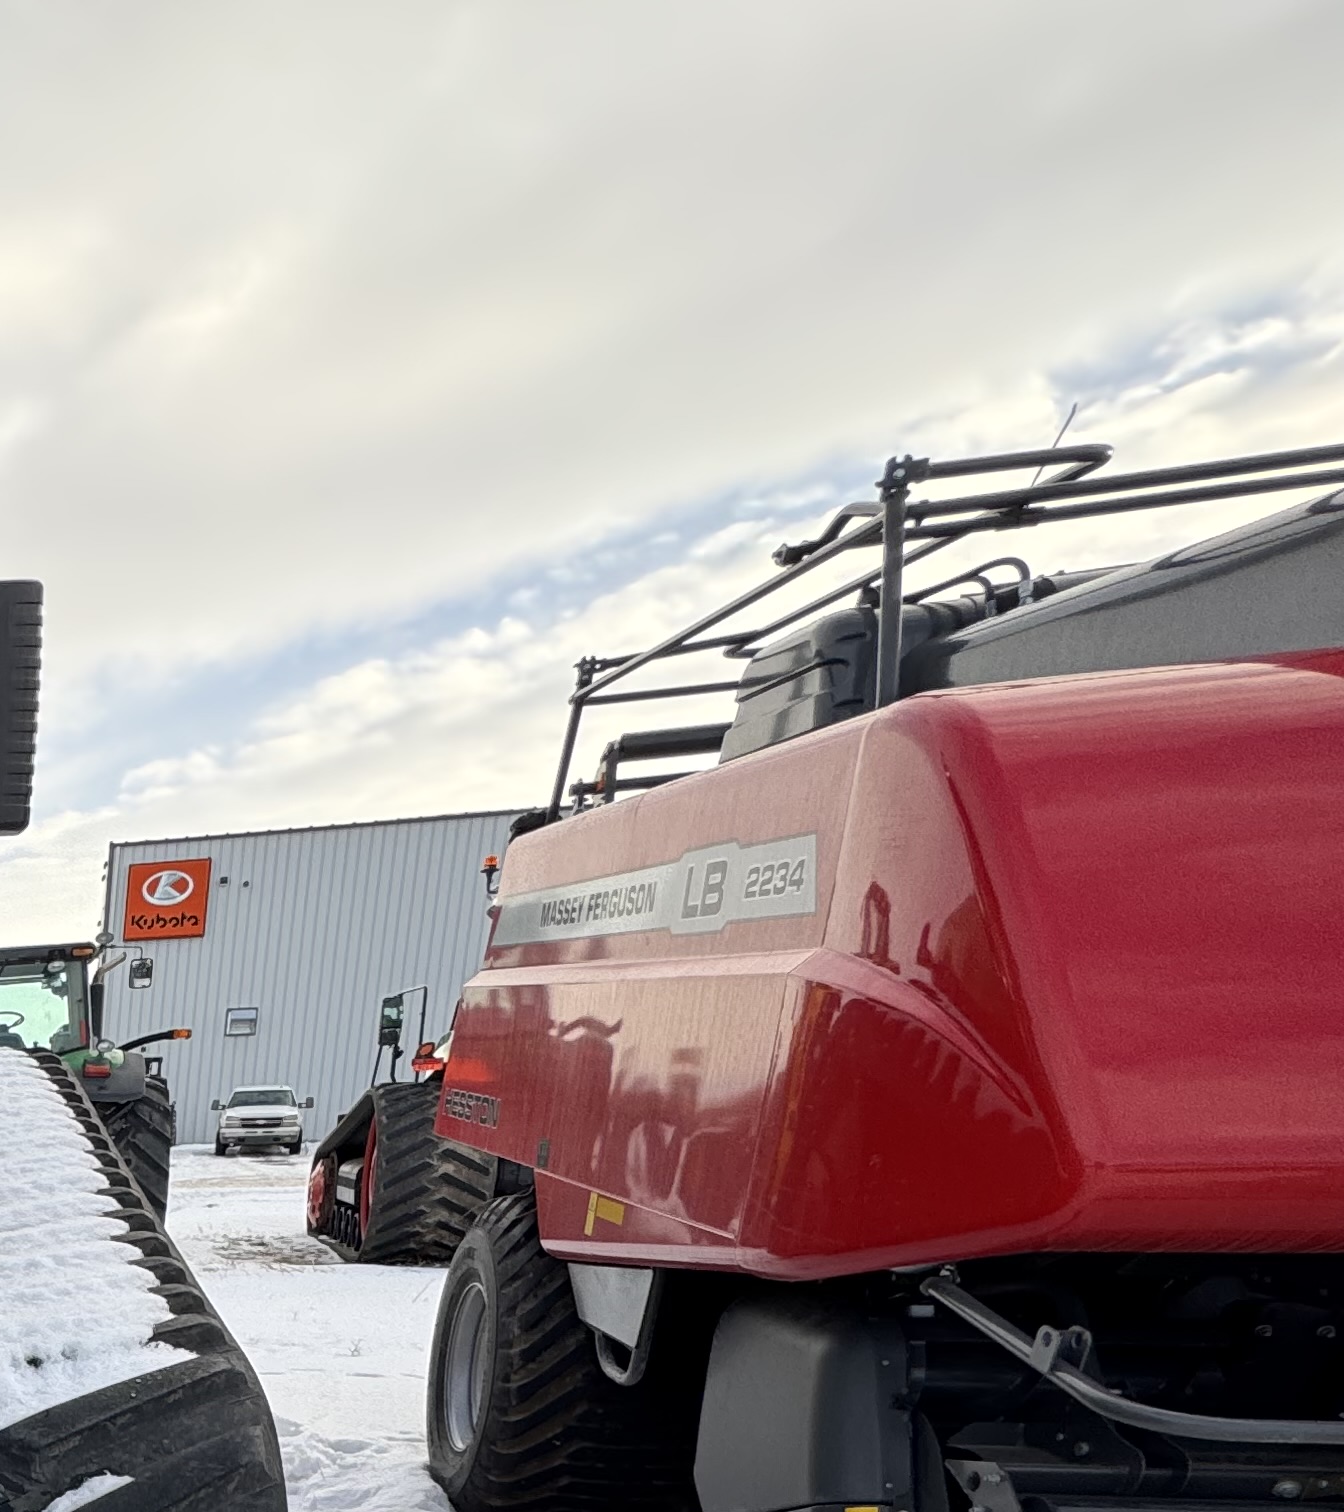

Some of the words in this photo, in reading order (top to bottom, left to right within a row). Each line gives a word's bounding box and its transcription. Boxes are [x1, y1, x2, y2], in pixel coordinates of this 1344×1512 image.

[540, 896, 585, 927] MASSEY
[586, 881, 658, 922] FERGUSON
[681, 857, 728, 919] LB
[744, 856, 806, 900] 2234
[131, 912, 200, 930] Kubota
[442, 1088, 501, 1129] HESSTON
